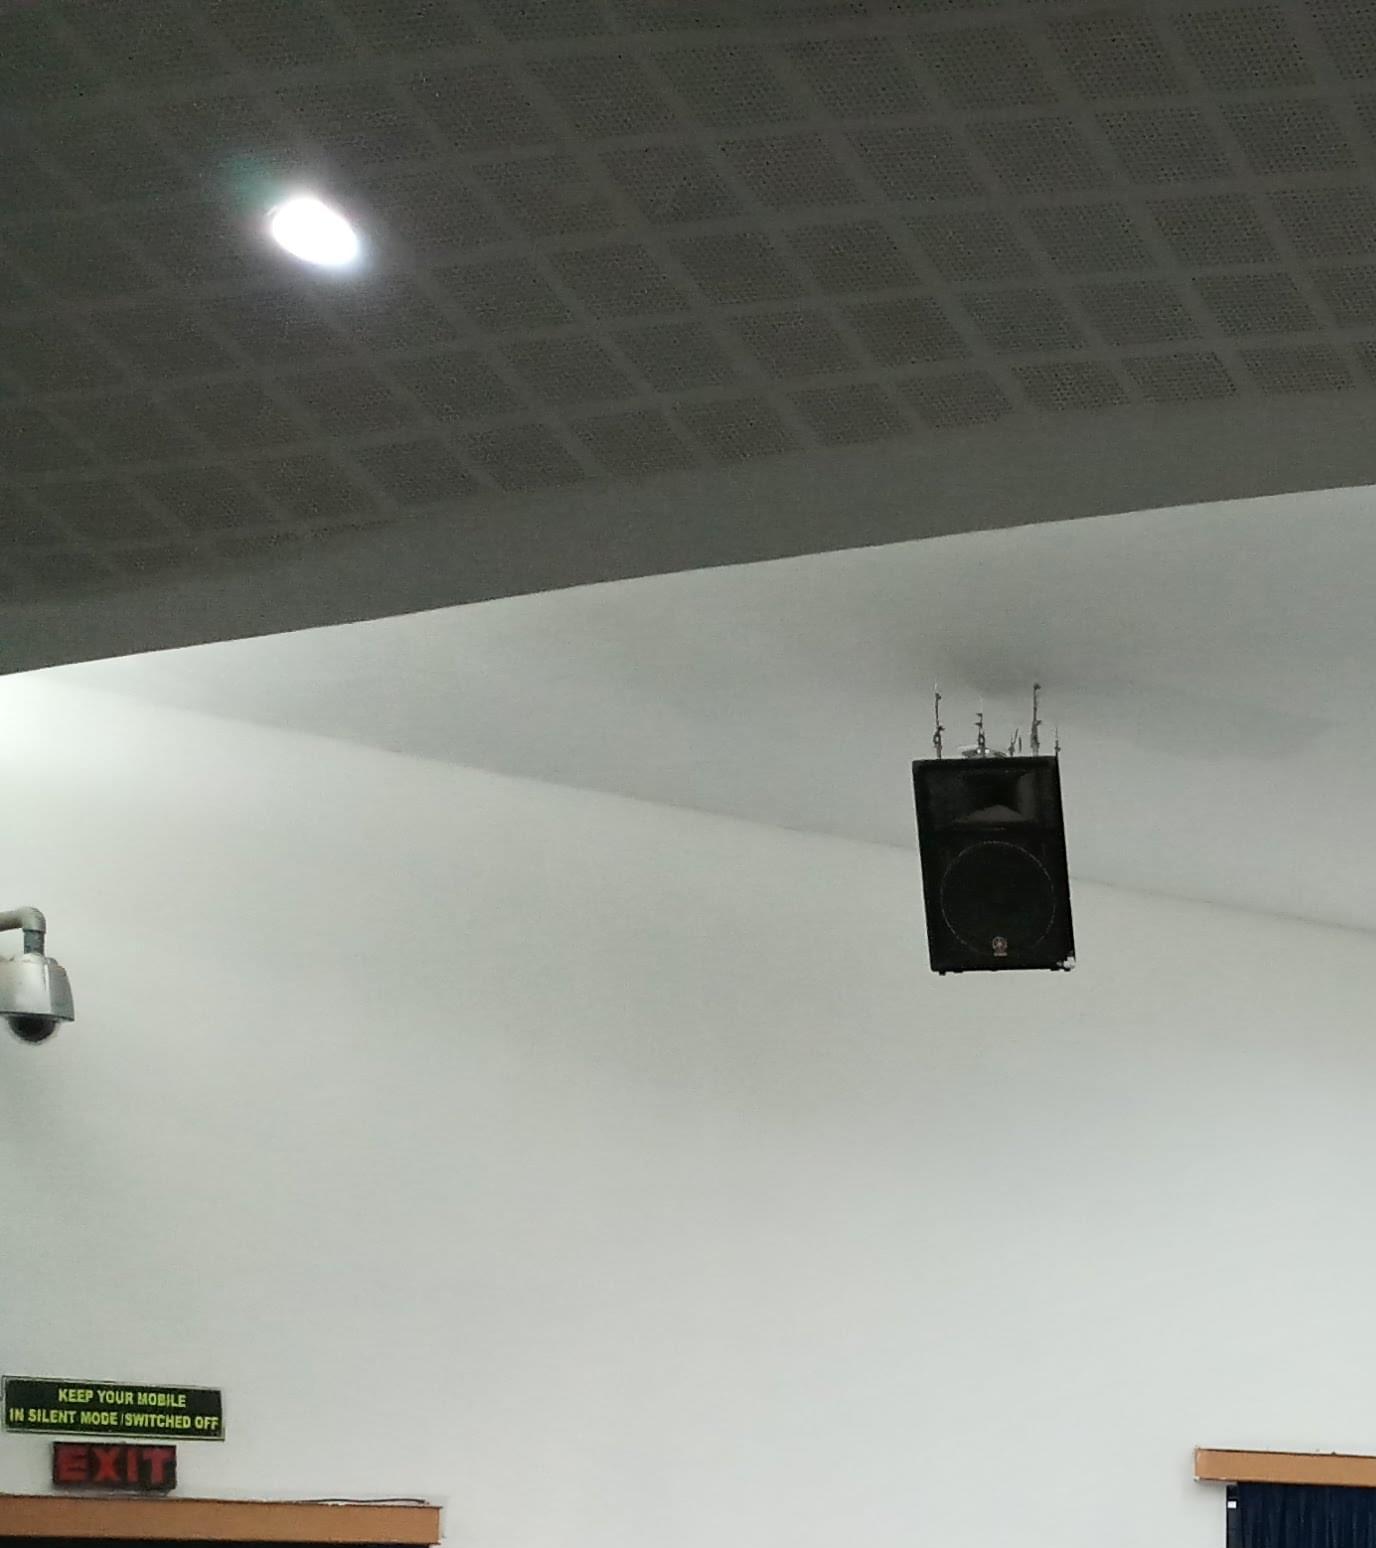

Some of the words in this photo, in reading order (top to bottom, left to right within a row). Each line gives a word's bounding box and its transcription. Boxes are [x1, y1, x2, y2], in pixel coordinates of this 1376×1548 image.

[58, 1387, 94, 1403] KEEP
[97, 1389, 134, 1405] YOUR
[137, 1392, 187, 1408] MOBILE
[9, 1407, 25, 1422] IN
[27, 1408, 77, 1424] SILENT
[80, 1410, 119, 1426] MODE
[194, 1415, 220, 1431] OFF
[57, 1445, 174, 1484] EXIT
